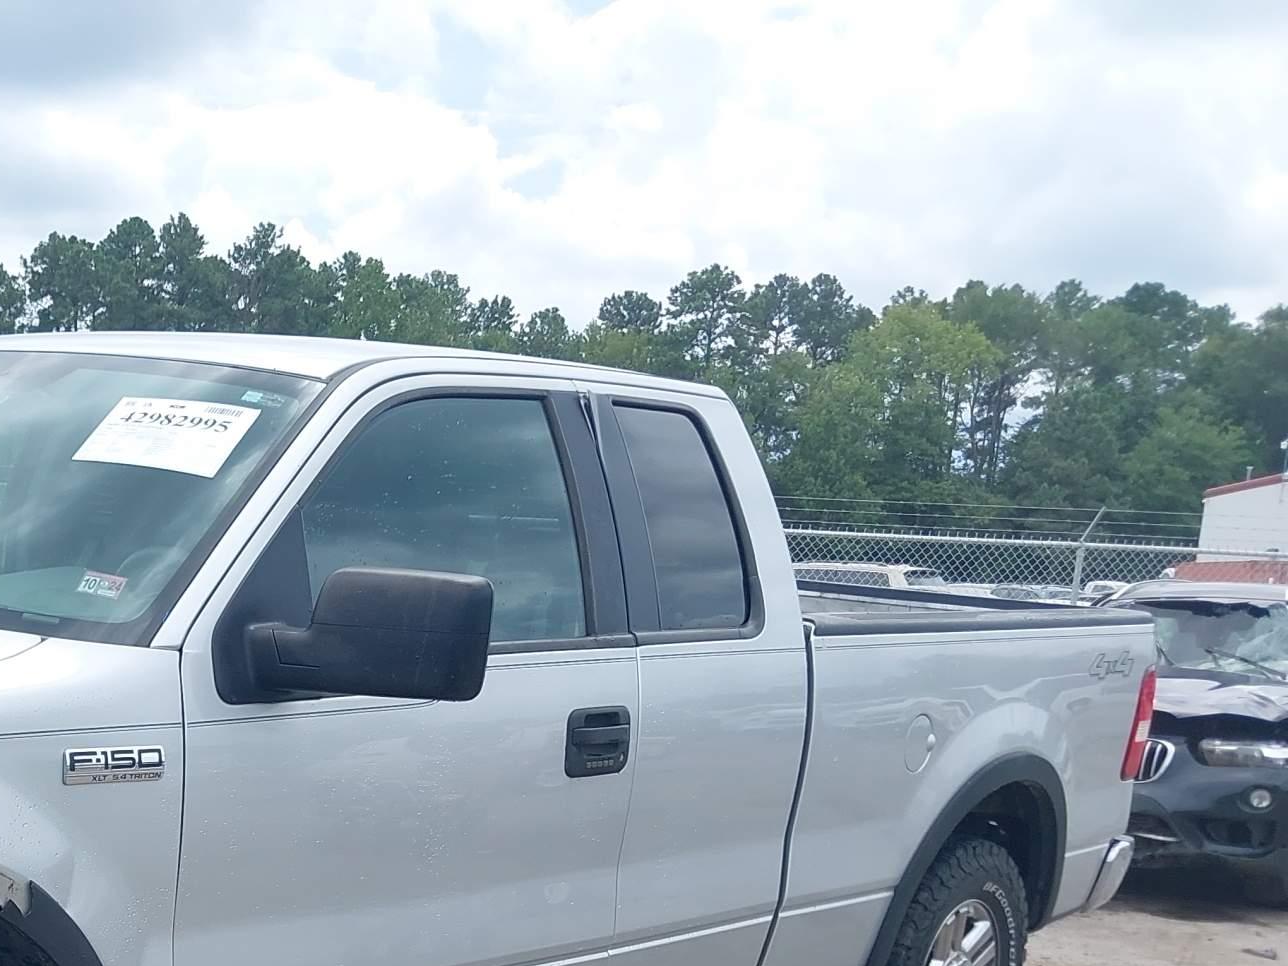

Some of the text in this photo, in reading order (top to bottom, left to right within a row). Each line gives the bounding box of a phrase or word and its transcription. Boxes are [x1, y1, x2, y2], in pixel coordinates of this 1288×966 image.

[120, 412, 233, 433] 42982995
[69, 748, 163, 771] F-150
[91, 774, 108, 782] XLT
[128, 771, 162, 780] TRITON
